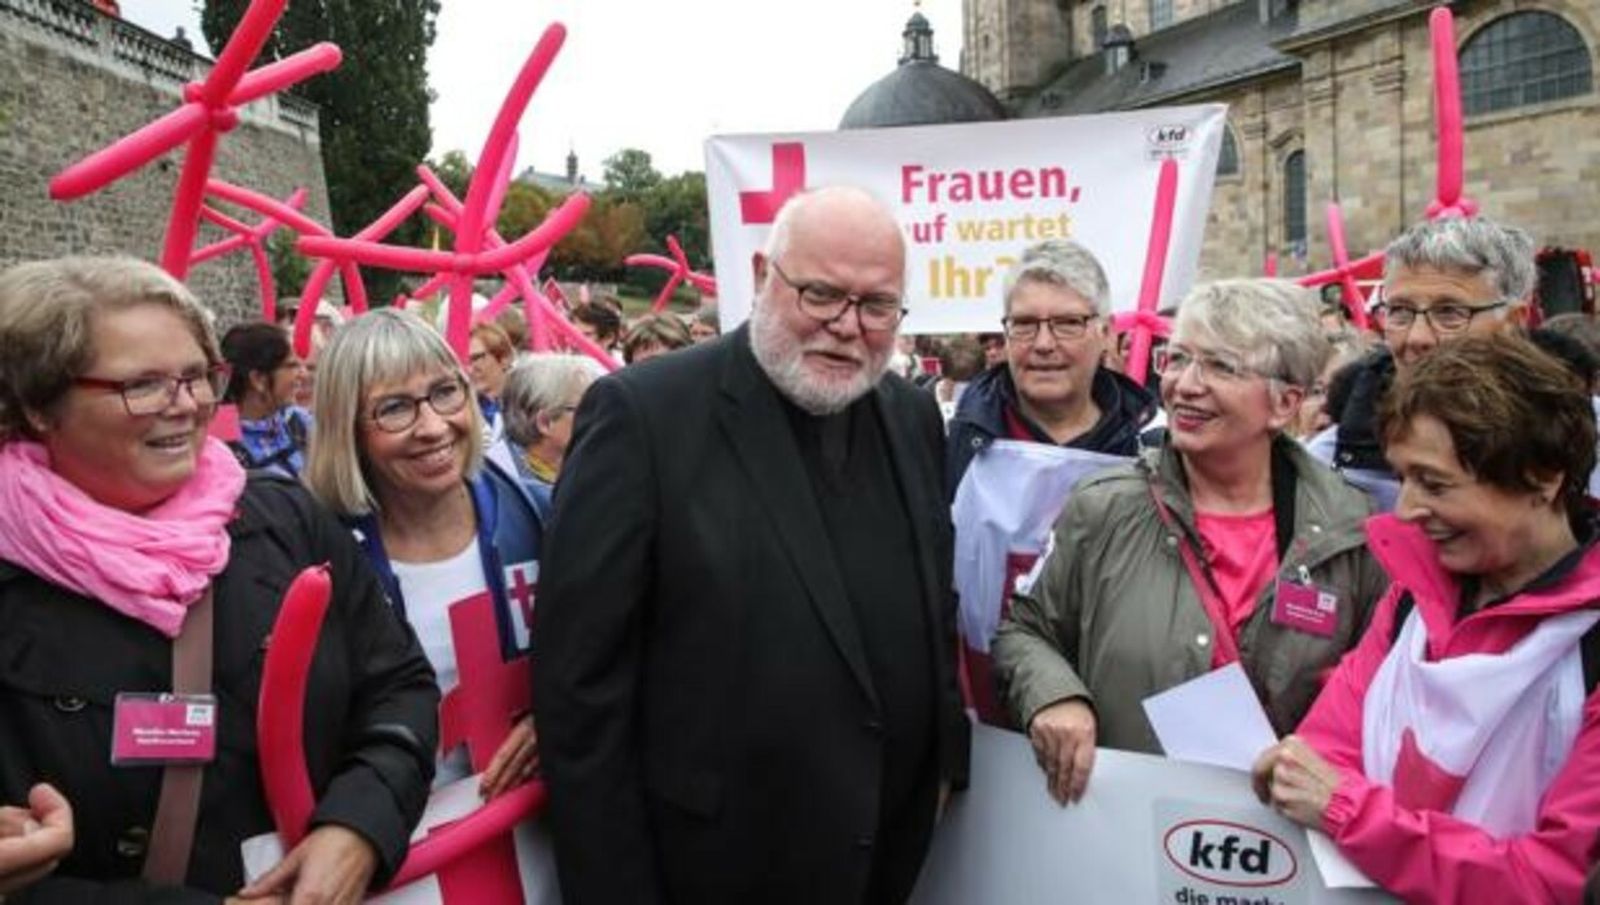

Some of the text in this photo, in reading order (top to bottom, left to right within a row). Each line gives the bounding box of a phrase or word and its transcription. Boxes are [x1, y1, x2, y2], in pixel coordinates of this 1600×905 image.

[1158, 127, 1187, 142] kfd
[901, 164, 1081, 203] Frauen,
[905, 212, 1070, 243] uf wartet
[1190, 830, 1271, 875] kfd
[1175, 886, 1210, 905] die
